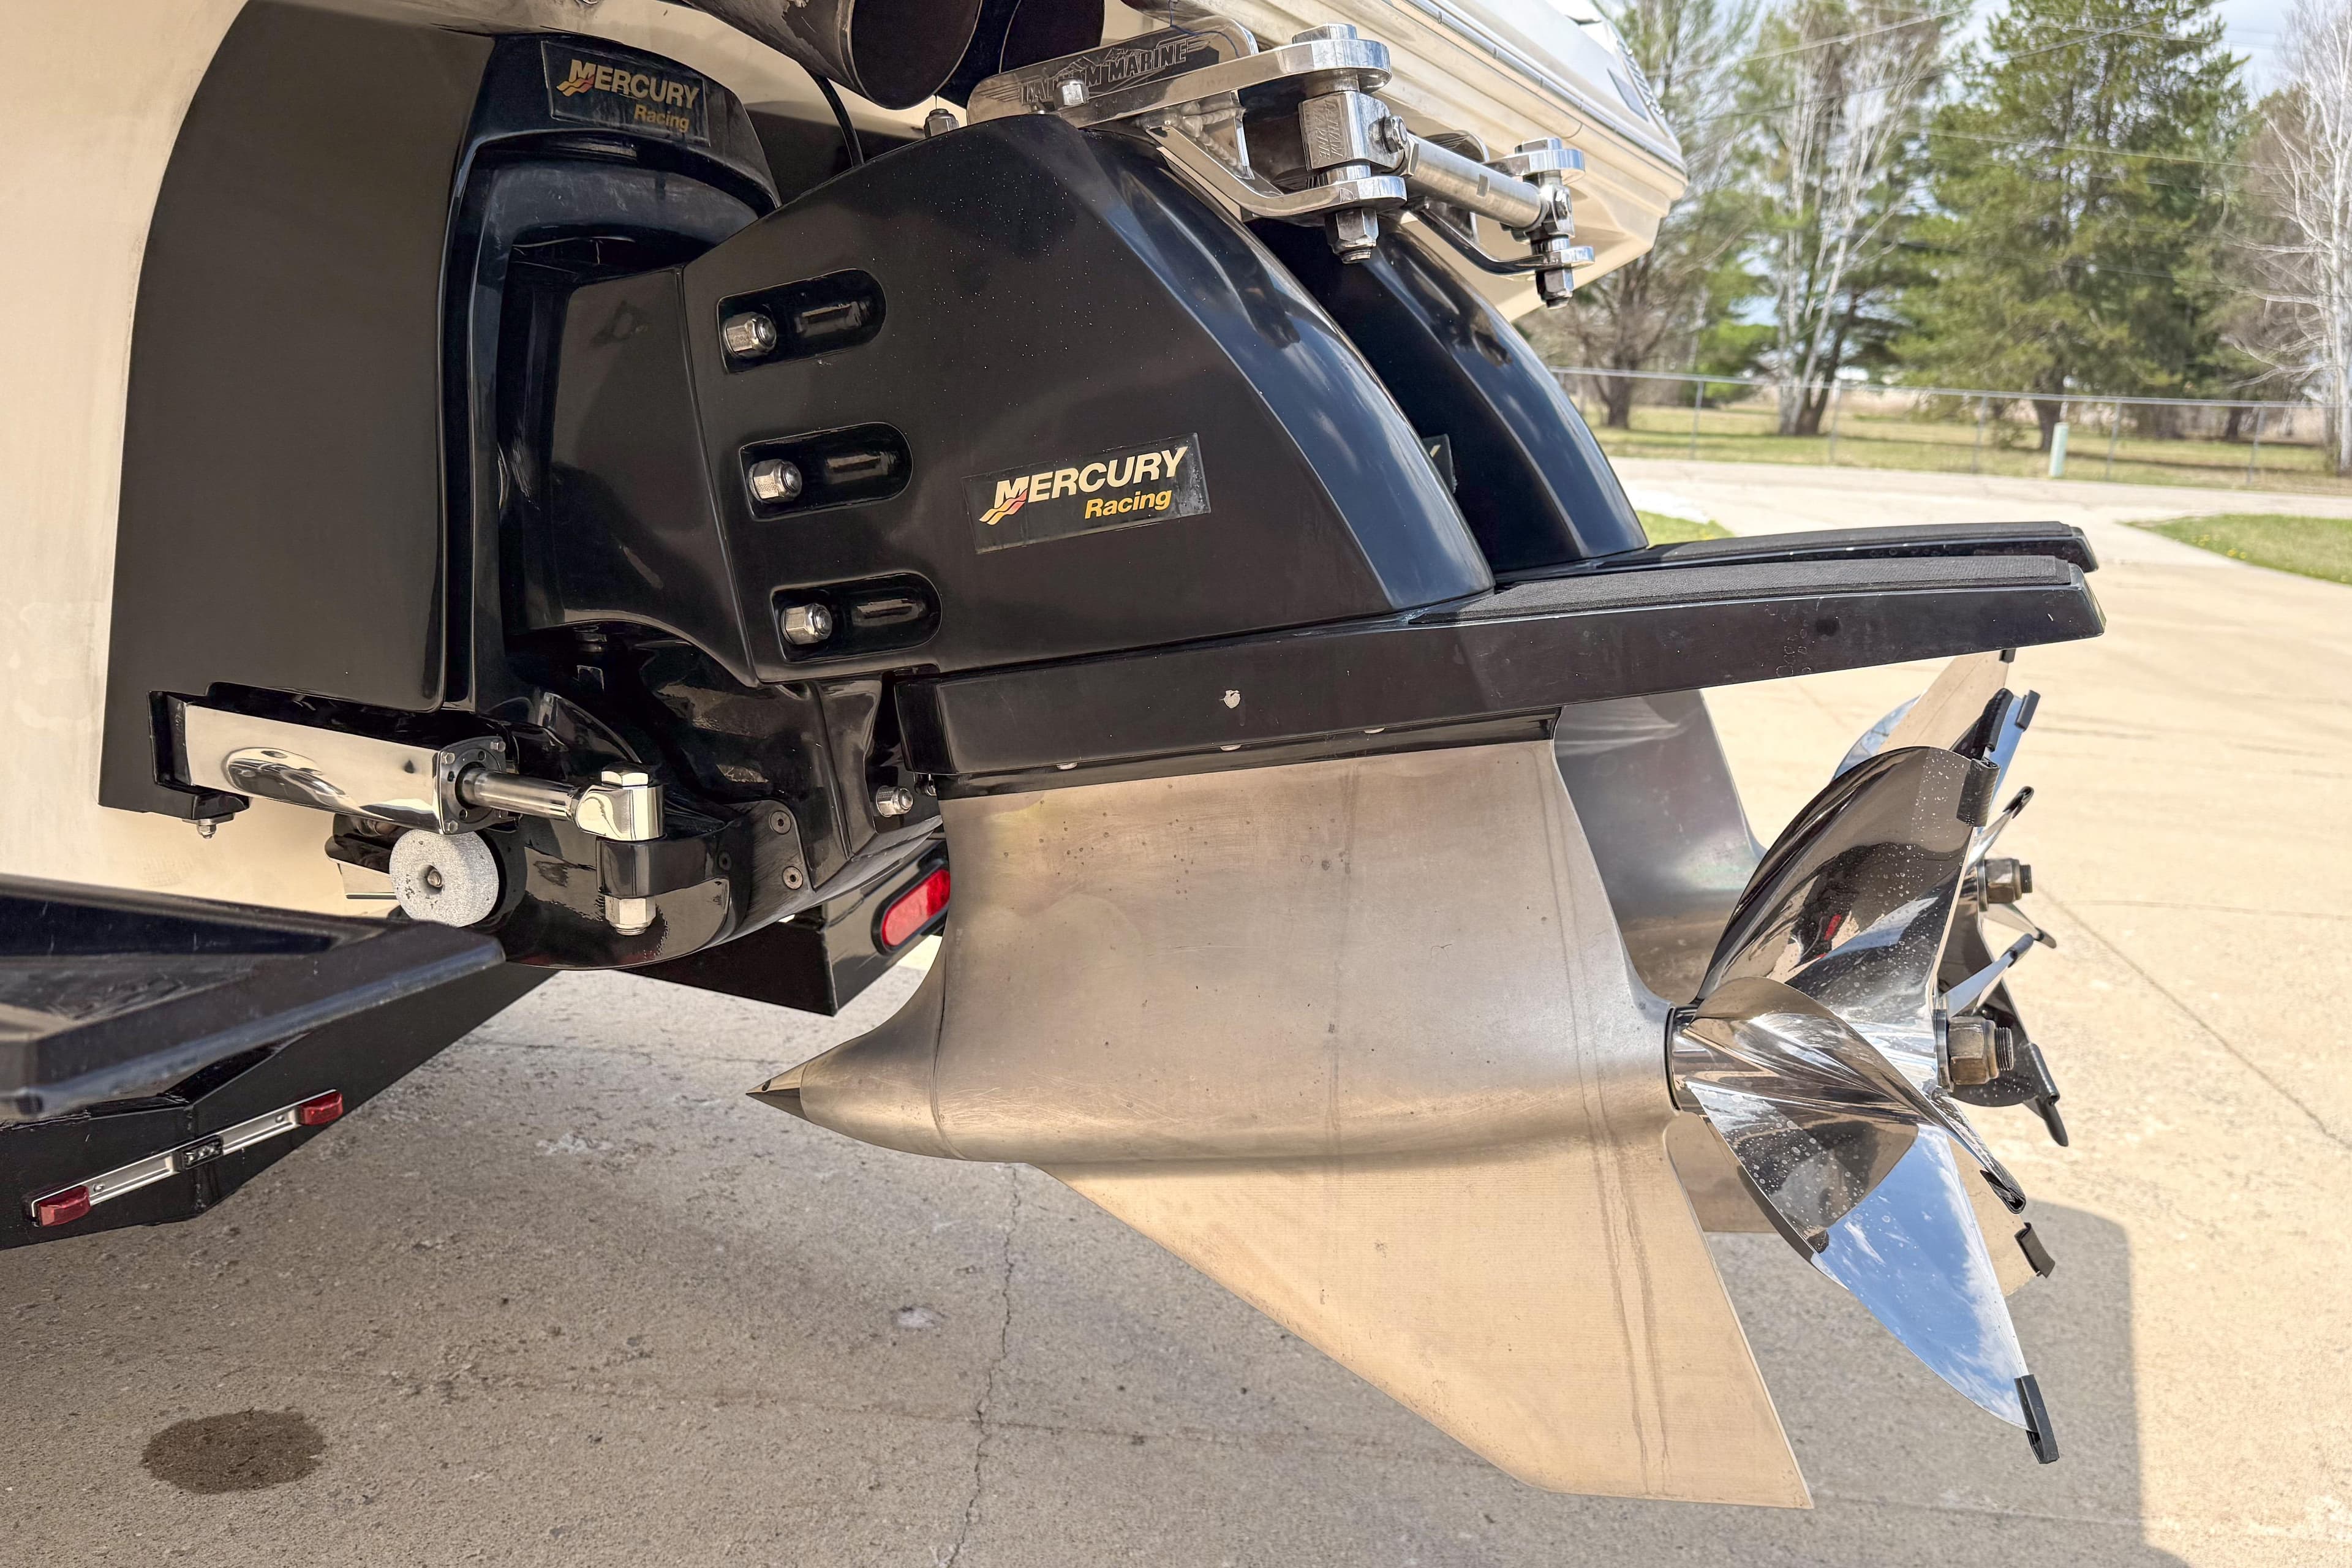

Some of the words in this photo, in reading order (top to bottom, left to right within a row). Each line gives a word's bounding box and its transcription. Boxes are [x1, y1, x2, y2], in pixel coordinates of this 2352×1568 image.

[1109, 40, 1187, 83] MARINE
[568, 59, 699, 109] MERCURY
[634, 104, 690, 133] Racing
[993, 446, 1189, 508] MERCURY
[1085, 489, 1172, 520] Racing
